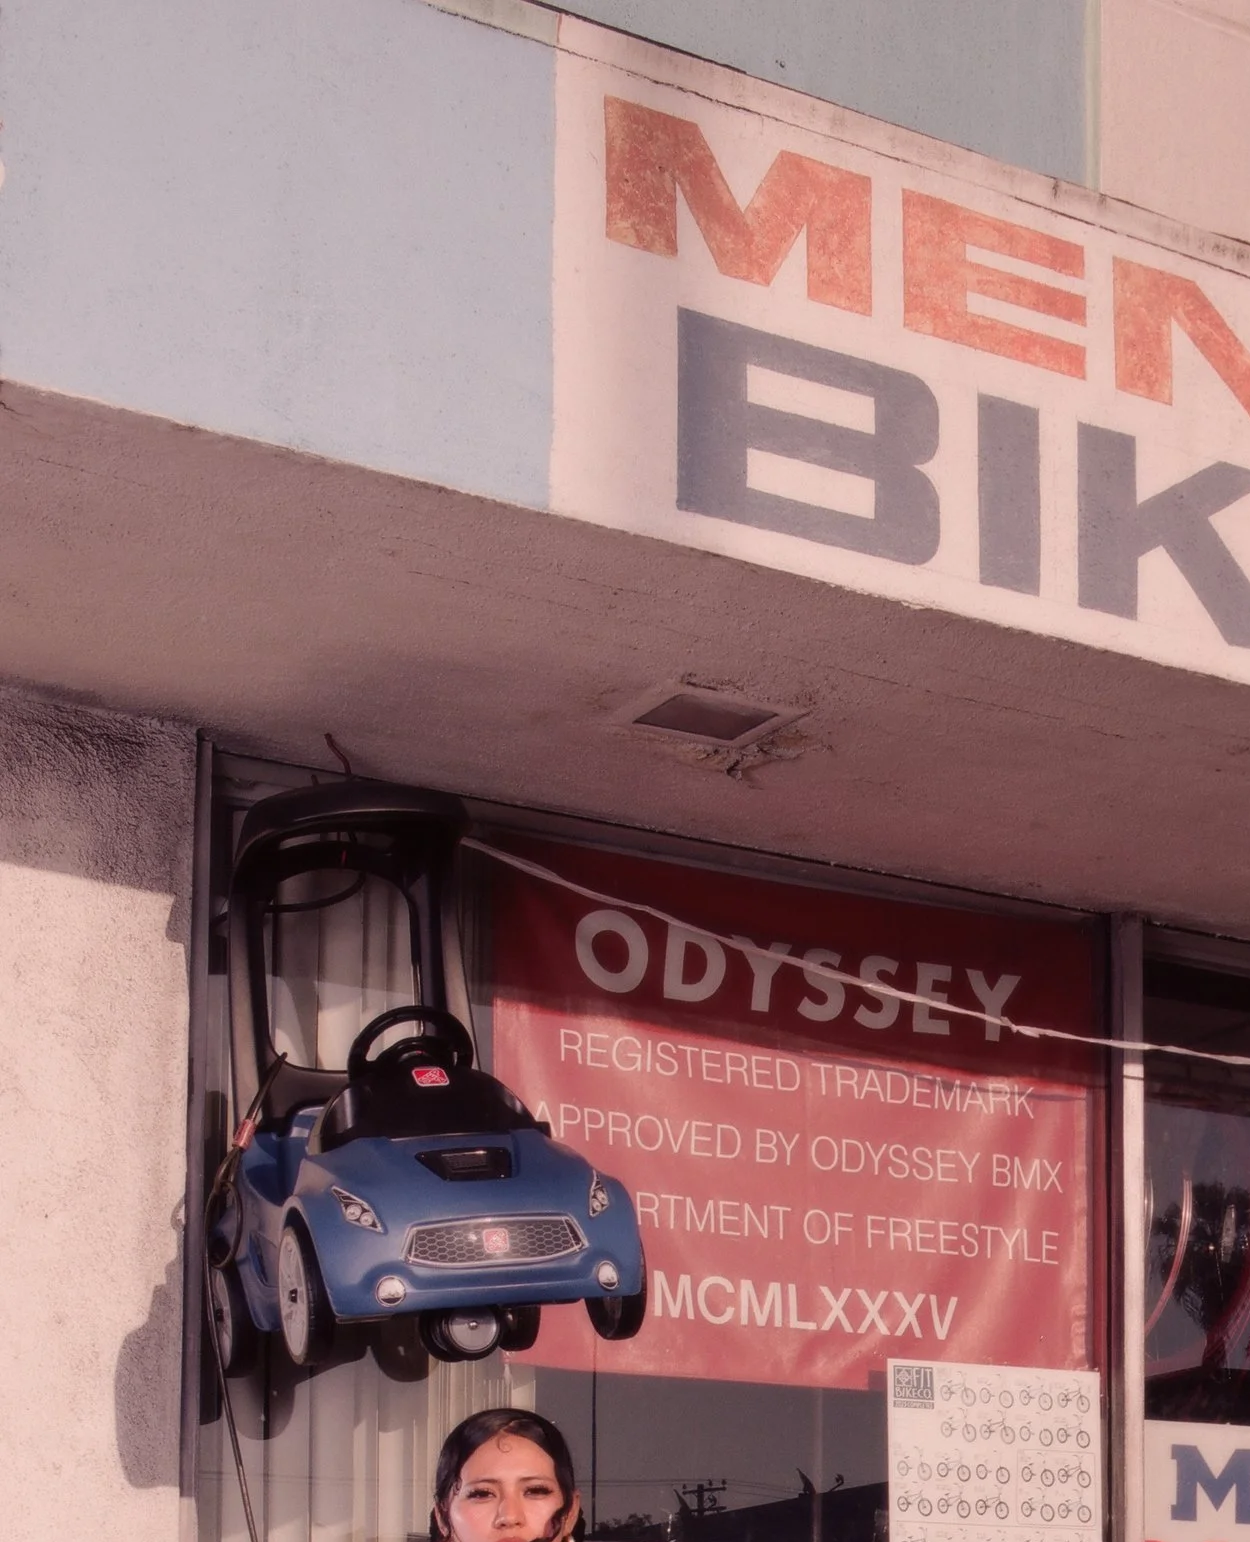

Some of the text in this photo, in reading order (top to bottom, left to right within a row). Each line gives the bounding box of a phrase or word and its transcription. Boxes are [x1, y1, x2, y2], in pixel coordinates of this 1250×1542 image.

[575, 909, 1021, 1042] ODYSSEY
[559, 1029, 1035, 1119] REGISTERED TRADEMARK
[534, 1101, 1063, 1193] APPROVED BY ODYSSEY BMX
[804, 1209, 854, 1246] OF
[867, 1216, 1059, 1265] FREESTYLE
[653, 1270, 958, 1341] MCMLXXXV
